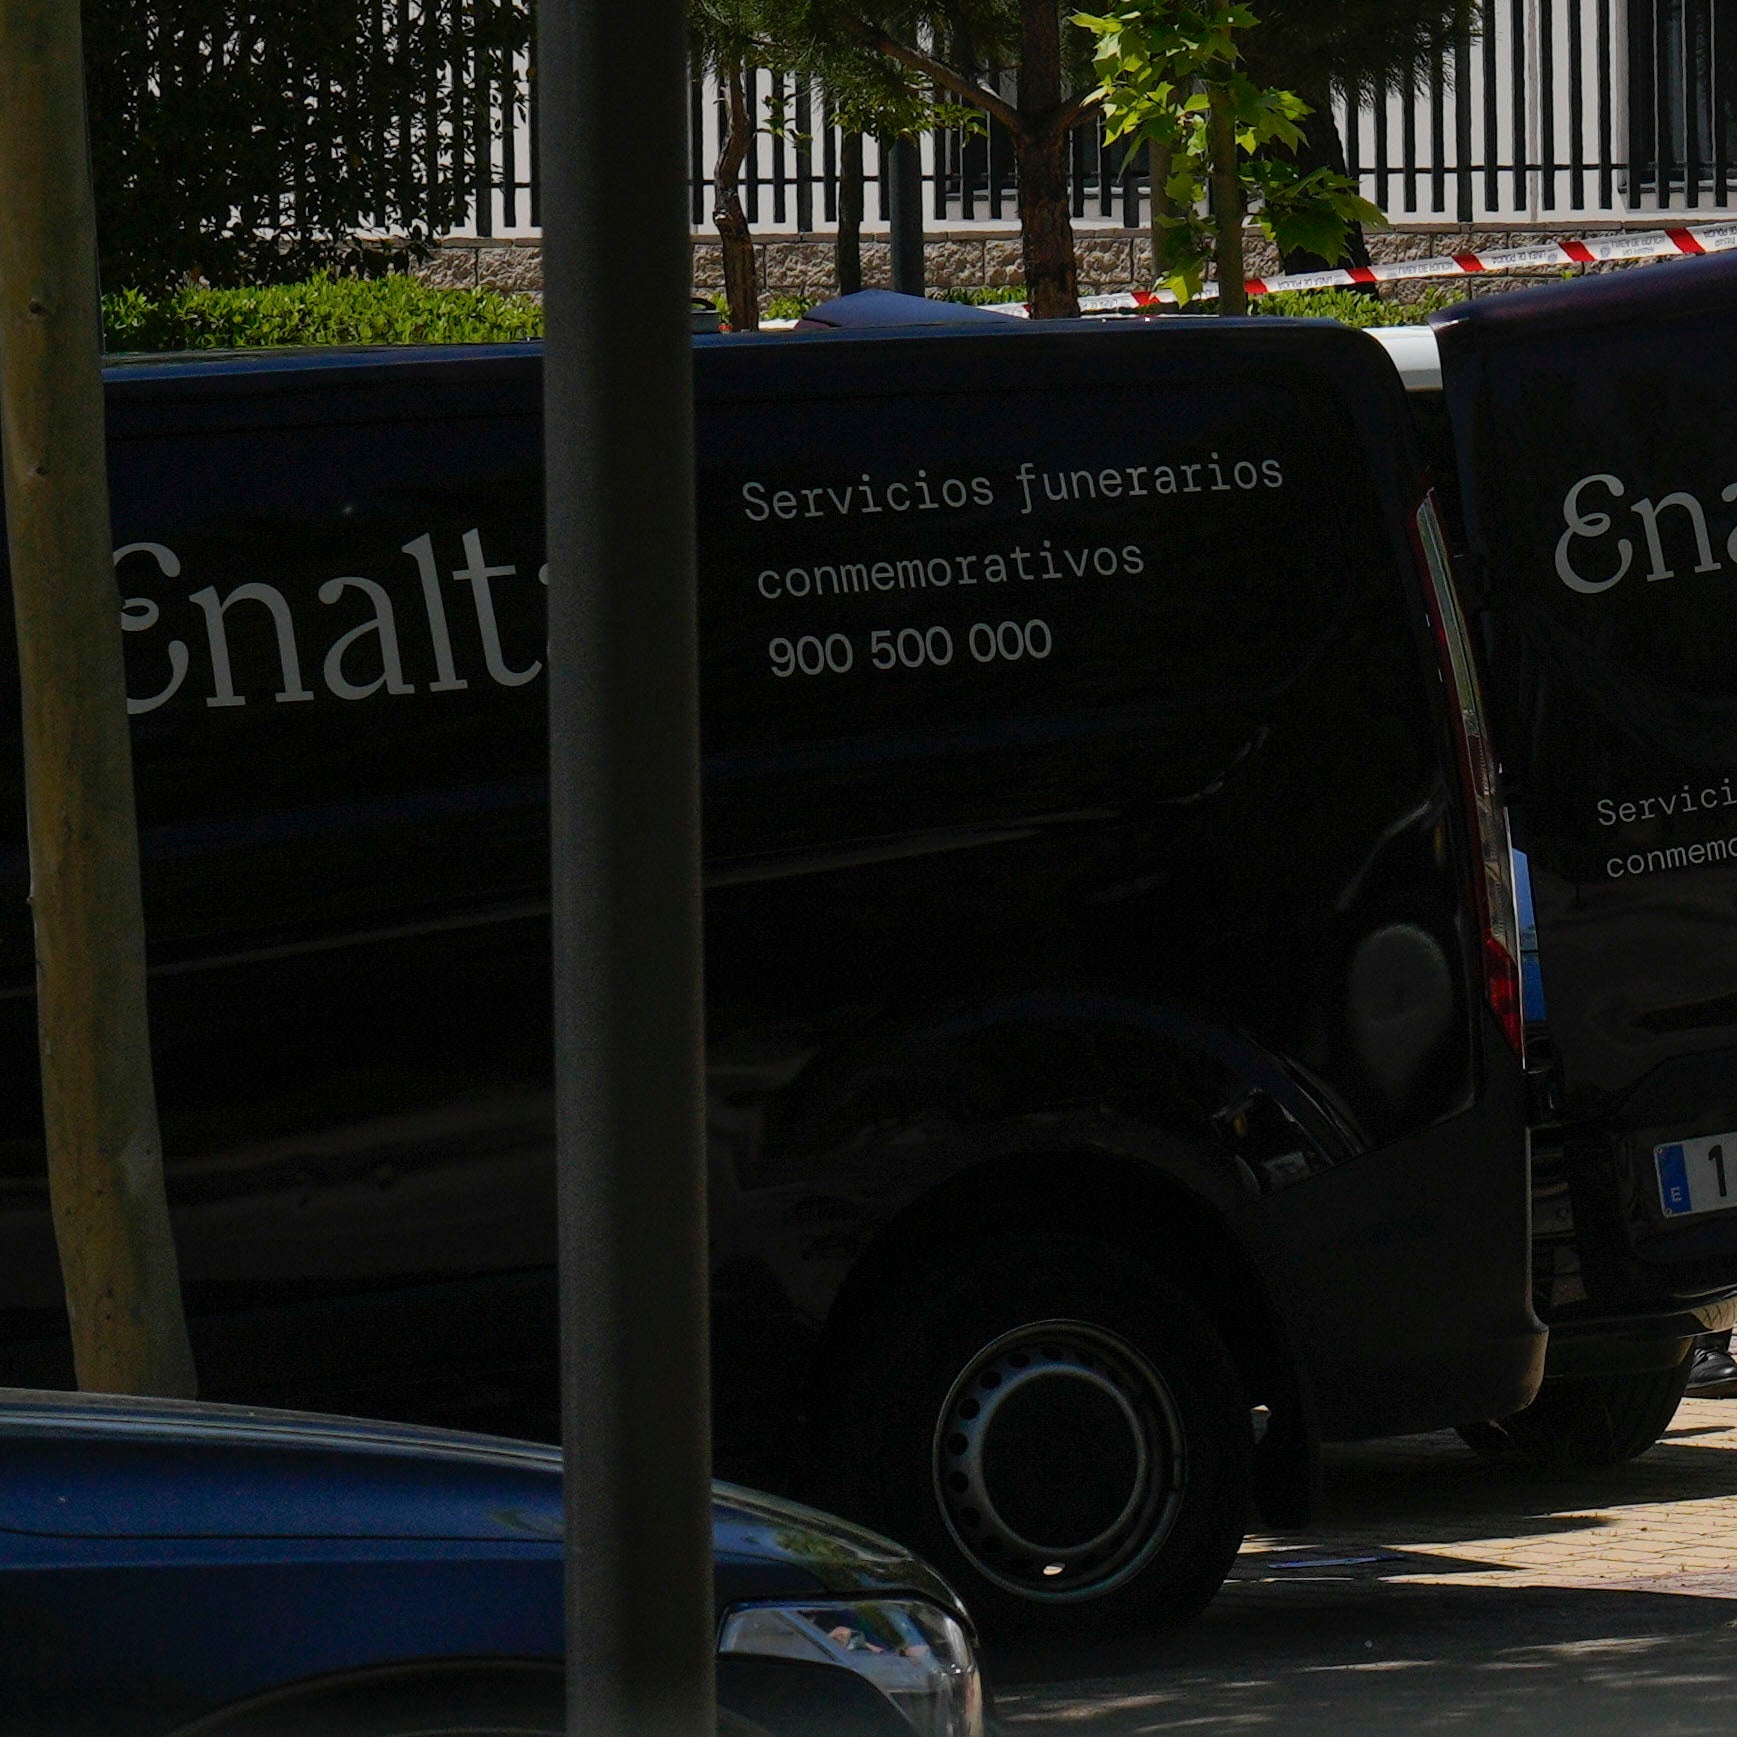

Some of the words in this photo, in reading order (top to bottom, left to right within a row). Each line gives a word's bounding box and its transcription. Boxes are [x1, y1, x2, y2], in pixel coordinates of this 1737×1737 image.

[743, 470, 994, 521] Servicios
[1015, 452, 1283, 514] funerarios
[757, 540, 1144, 598] conmemorativos
[115, 528, 549, 714] Enalt
[768, 633, 854, 677] 900
[871, 625, 954, 669] 500
[968, 618, 1053, 662] 000
